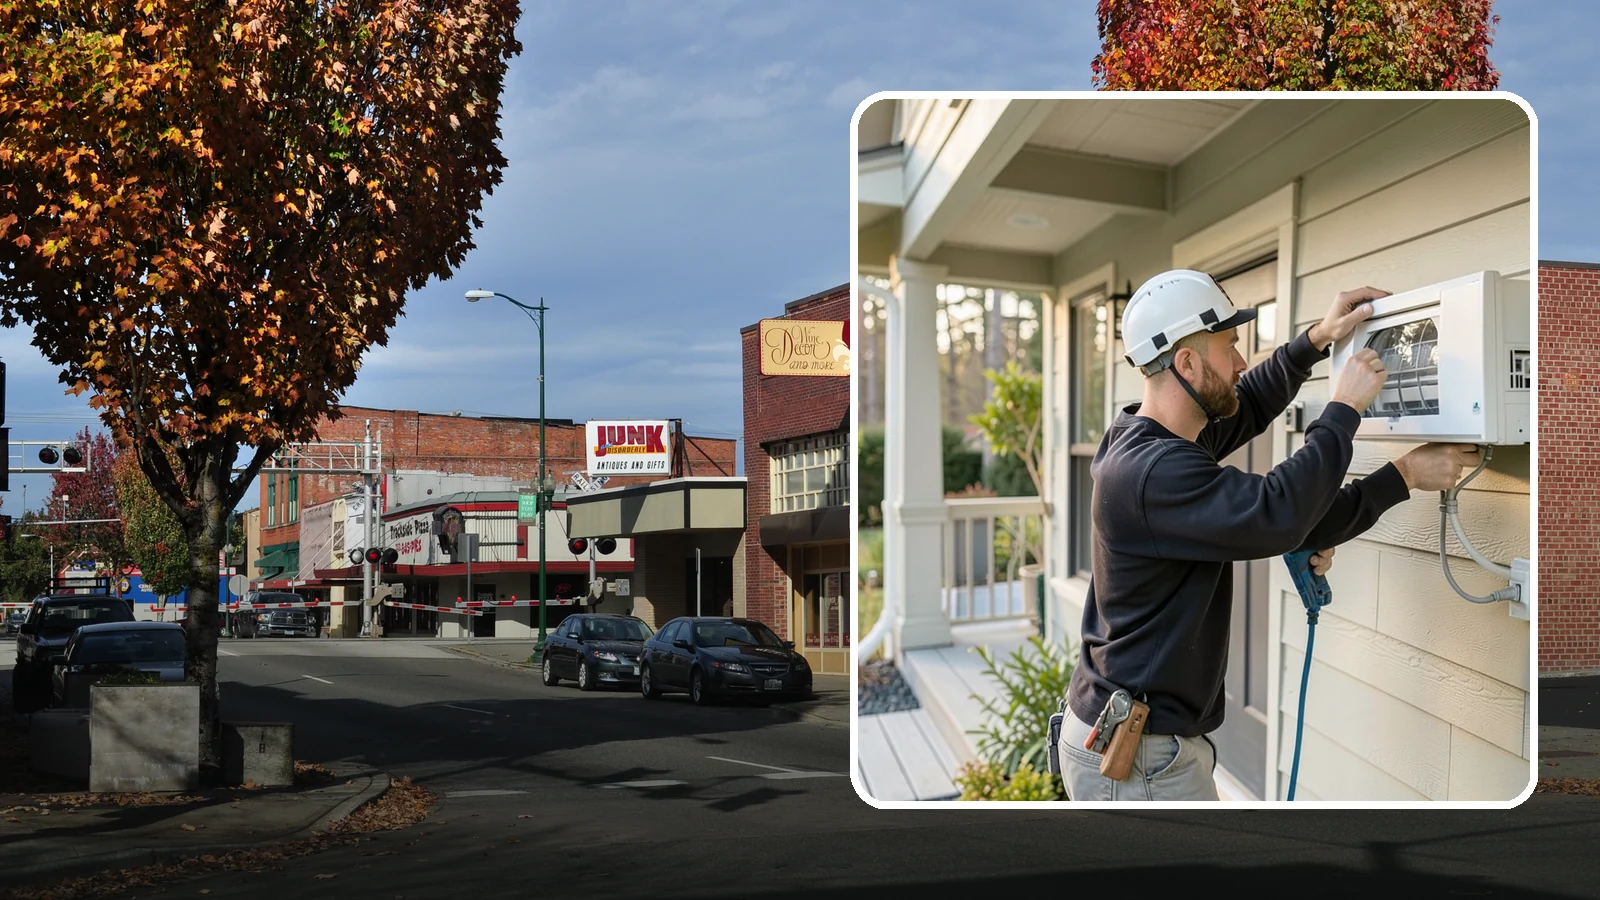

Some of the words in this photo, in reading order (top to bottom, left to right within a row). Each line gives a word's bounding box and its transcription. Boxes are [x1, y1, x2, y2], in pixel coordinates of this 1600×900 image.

[596, 425, 665, 457] JUNK
[607, 445, 646, 454] DISORDERLY
[597, 461, 628, 470] ANTIQUES
[631, 461, 644, 470] AND
[647, 460, 665, 469] GIFTS
[414, 519, 429, 535] Pizza
